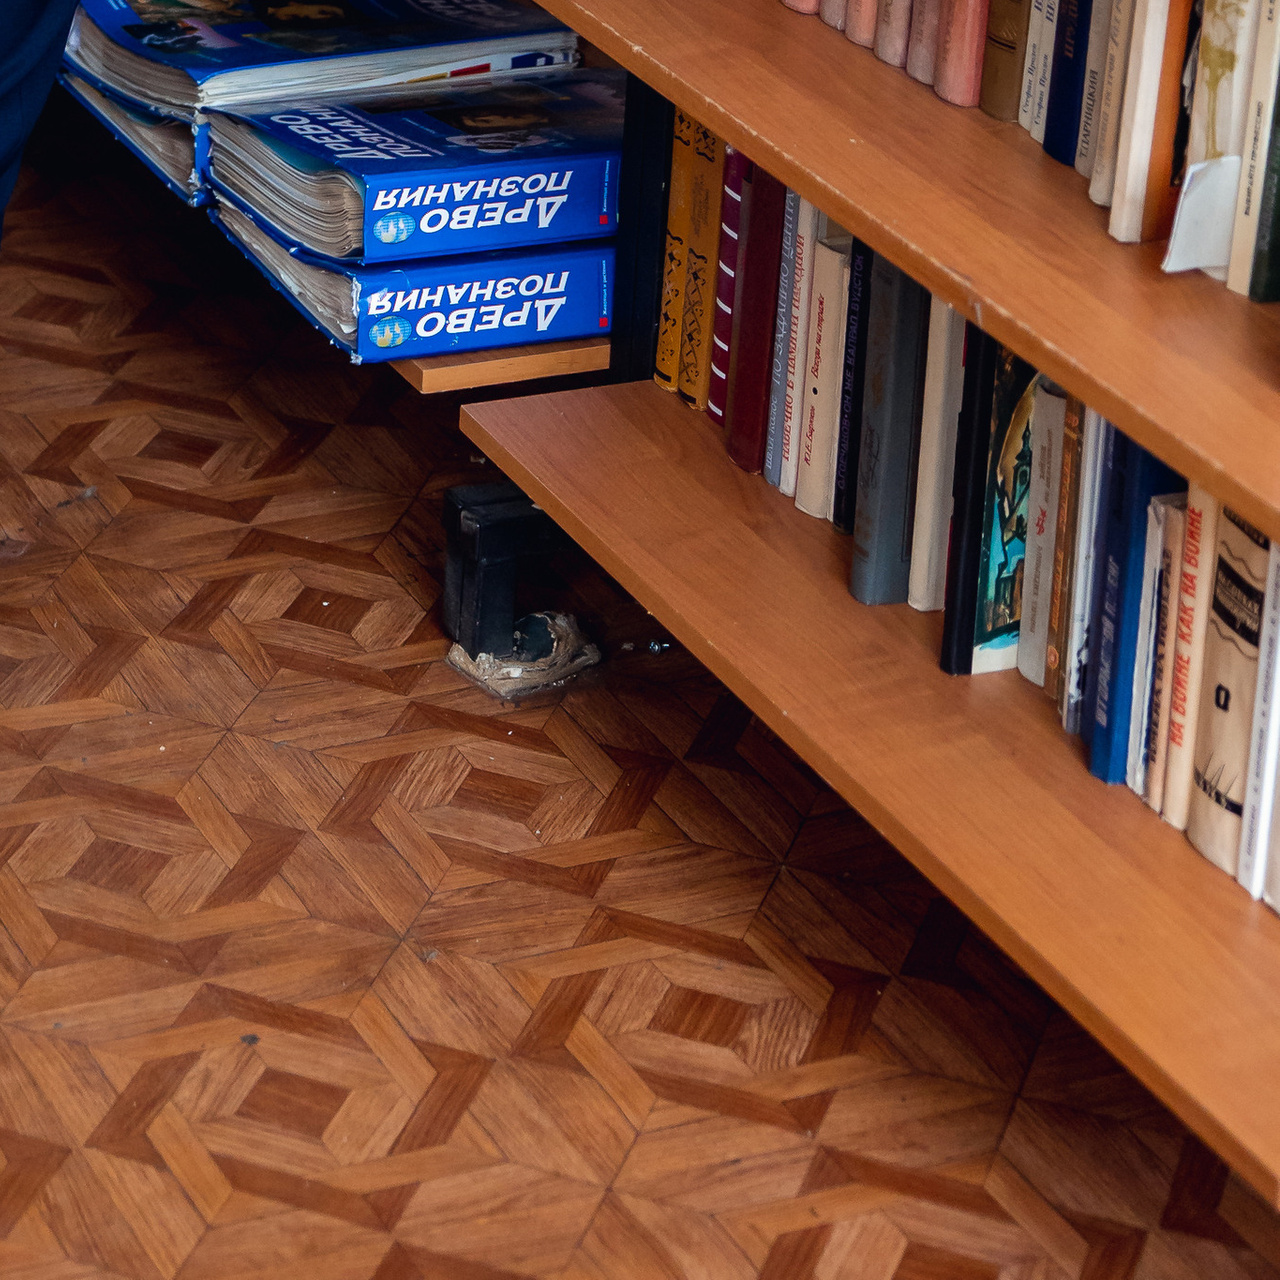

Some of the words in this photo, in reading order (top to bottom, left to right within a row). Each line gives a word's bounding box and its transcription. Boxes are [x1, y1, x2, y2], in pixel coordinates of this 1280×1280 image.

[1027, 43, 1037, 74] Продев
[1038, 54, 1049, 87] Продев
[1022, 78, 1033, 113] Стефан
[1033, 91, 1045, 125] Стефан
[1079, 69, 1098, 157] Т.ПАРНИЦКИЙ
[269, 113, 396, 160] ДРЕВО
[372, 171, 573, 211] ПОЗНАНИЯ
[419, 194, 568, 233] ДРЕВО
[782, 190, 795, 259] ЦЕНТРА
[792, 233, 805, 309] НАРОДНОЙ
[853, 254, 864, 310] ВУДСТОК
[368, 271, 570, 315] ПОЗНАНИЯ
[774, 263, 789, 354] ЗАДАНИЮ
[415, 296, 567, 337] ДРЕВО
[787, 314, 799, 376] ПАМЯТИ
[816, 334, 822, 344] на
[847, 316, 858, 365] КАПРАЛ
[773, 359, 783, 385] ПО
[811, 347, 823, 378] Всегда
[844, 370, 853, 391] ЖЕ
[786, 379, 794, 390] В
[843, 394, 851, 412] ОН
[782, 394, 793, 461] НАВЕЧНО
[1184, 506, 1202, 566] ВОЙНЕ
[1182, 572, 1196, 596] НА
[1178, 607, 1194, 645] КАК
[1172, 654, 1190, 715] ВОЙНЕ
[1169, 721, 1184, 747] НА
